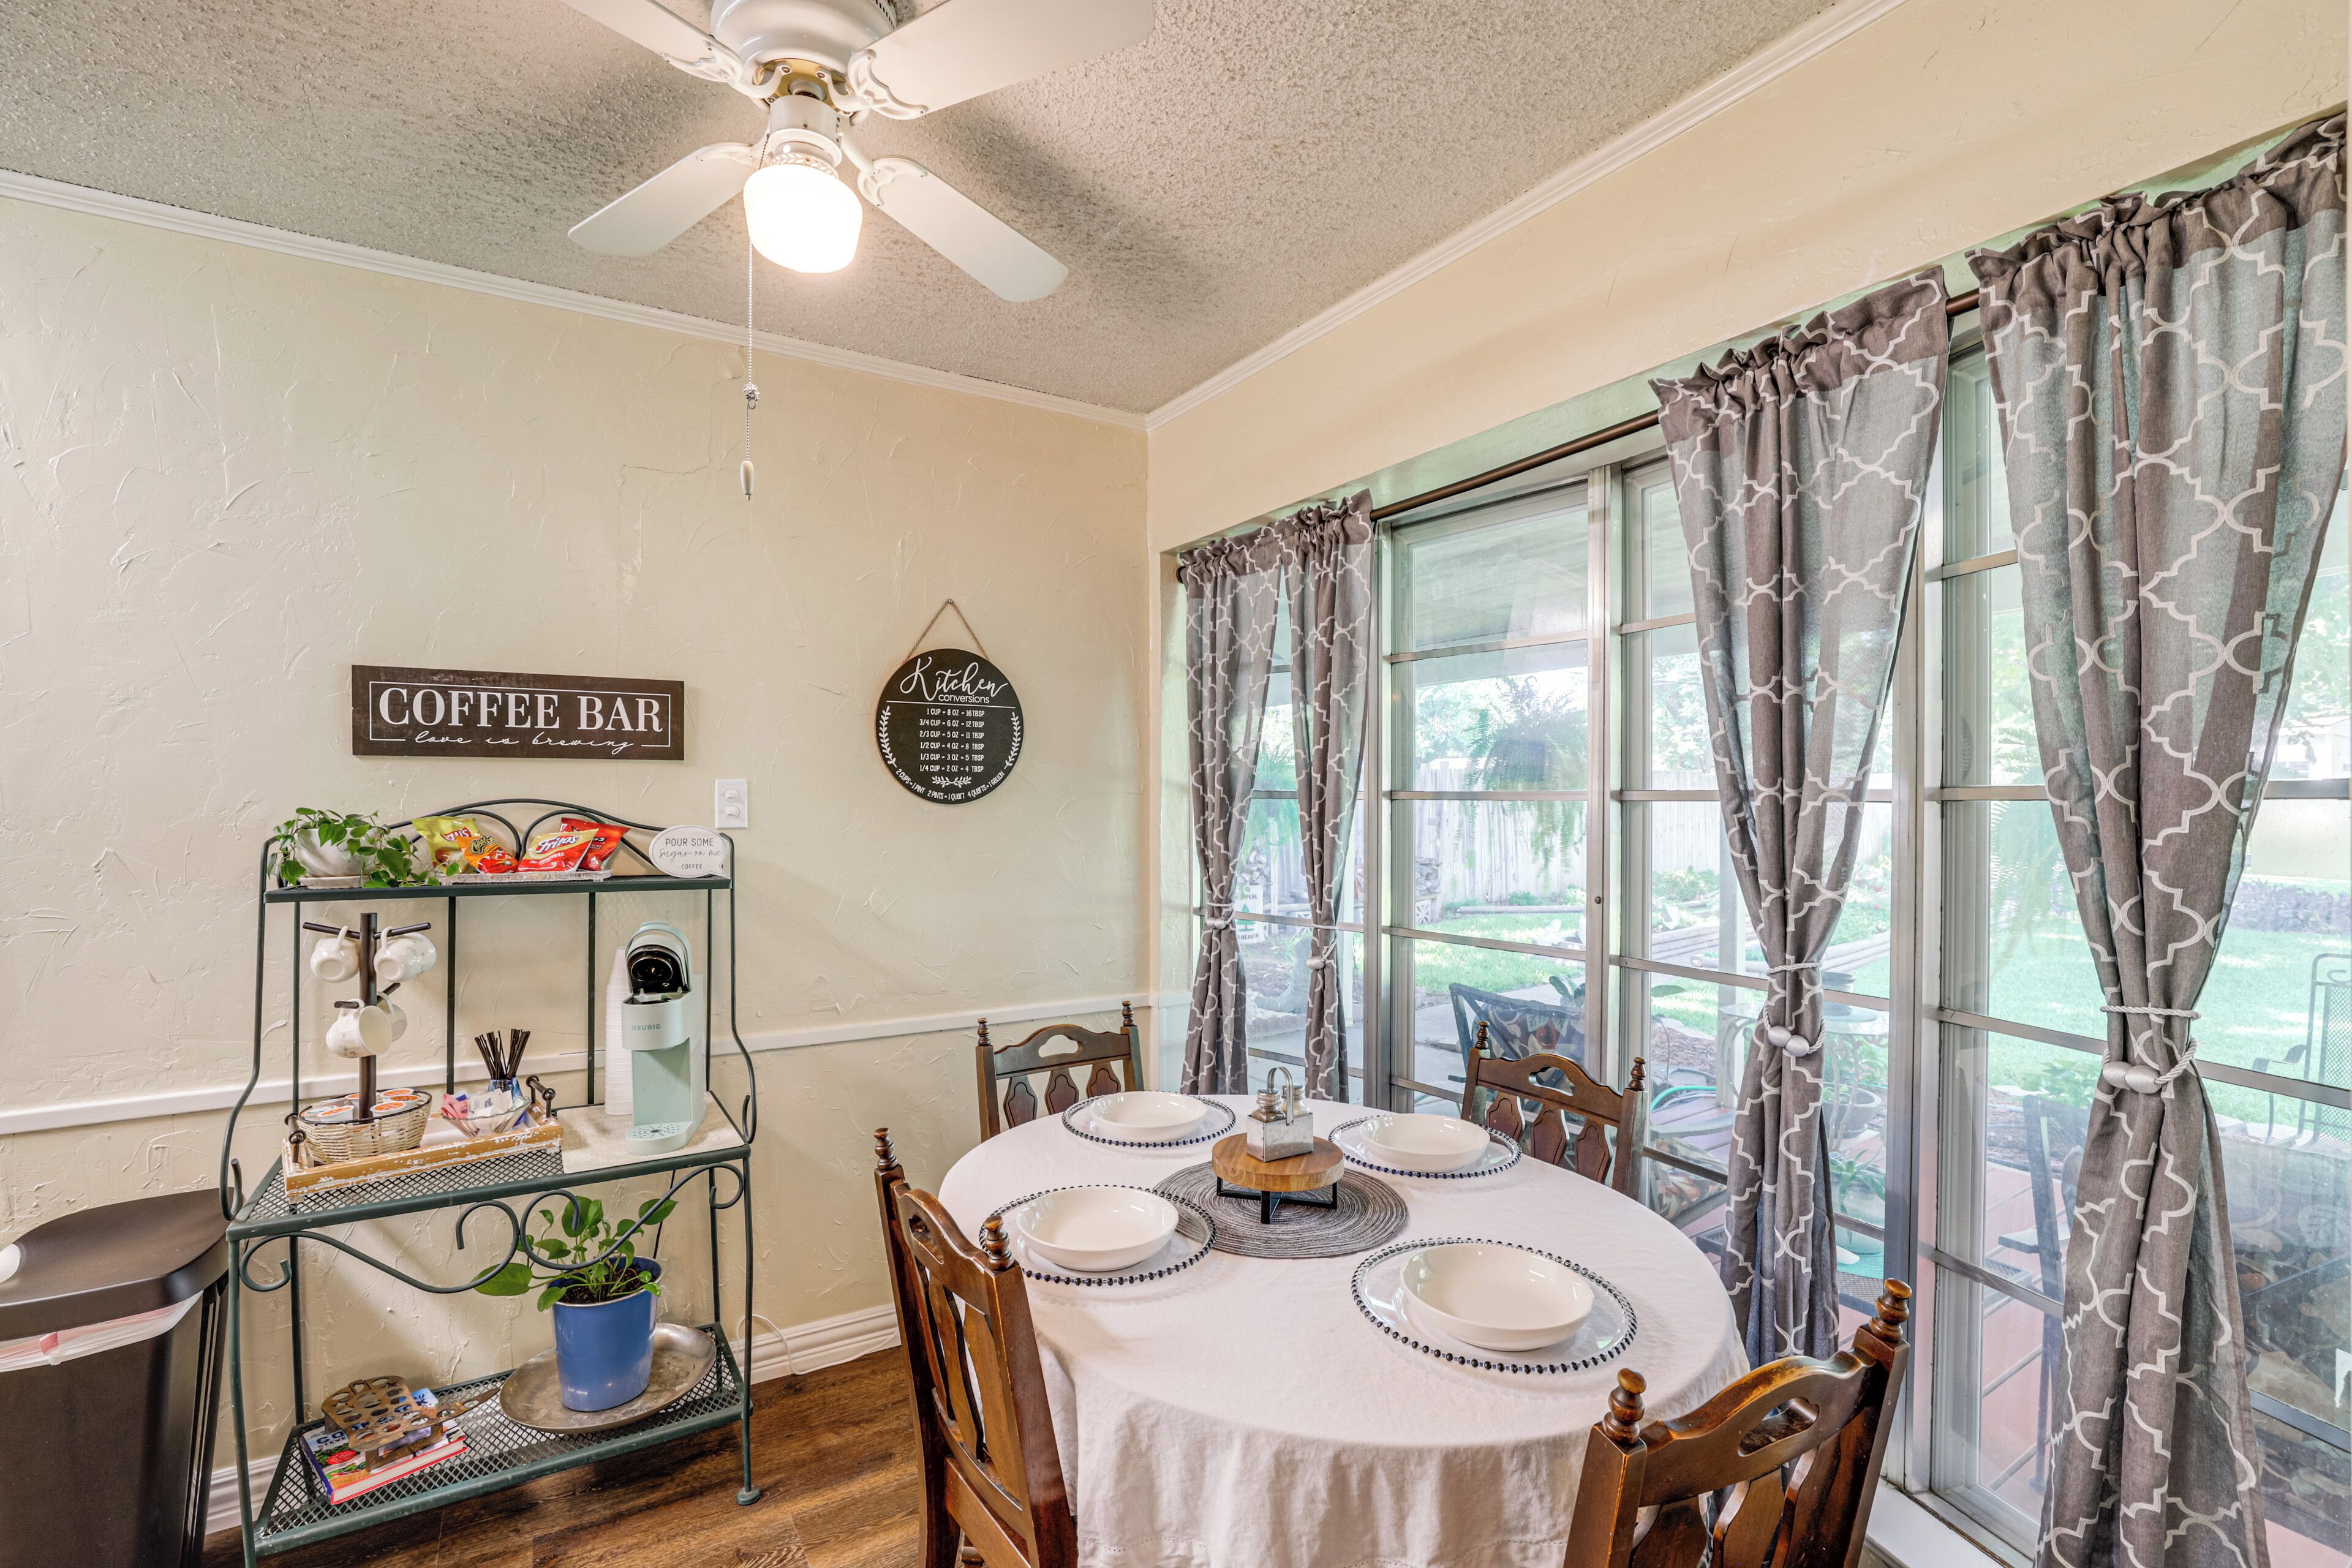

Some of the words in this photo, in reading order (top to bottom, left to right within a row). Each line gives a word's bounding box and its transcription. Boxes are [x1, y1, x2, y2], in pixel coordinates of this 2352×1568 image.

[900, 657, 1008, 701] Kitchen
[379, 687, 559, 728] COFFEE
[578, 696, 662, 732] BAR
[938, 694, 989, 703] conversions
[415, 731, 471, 744] love
[486, 734, 519, 744] is
[532, 731, 634, 755] brewing
[899, 772, 911, 784] CUPS
[914, 784, 925, 794] PINT
[931, 791, 944, 799] PINTS
[535, 835, 578, 854] Fritos
